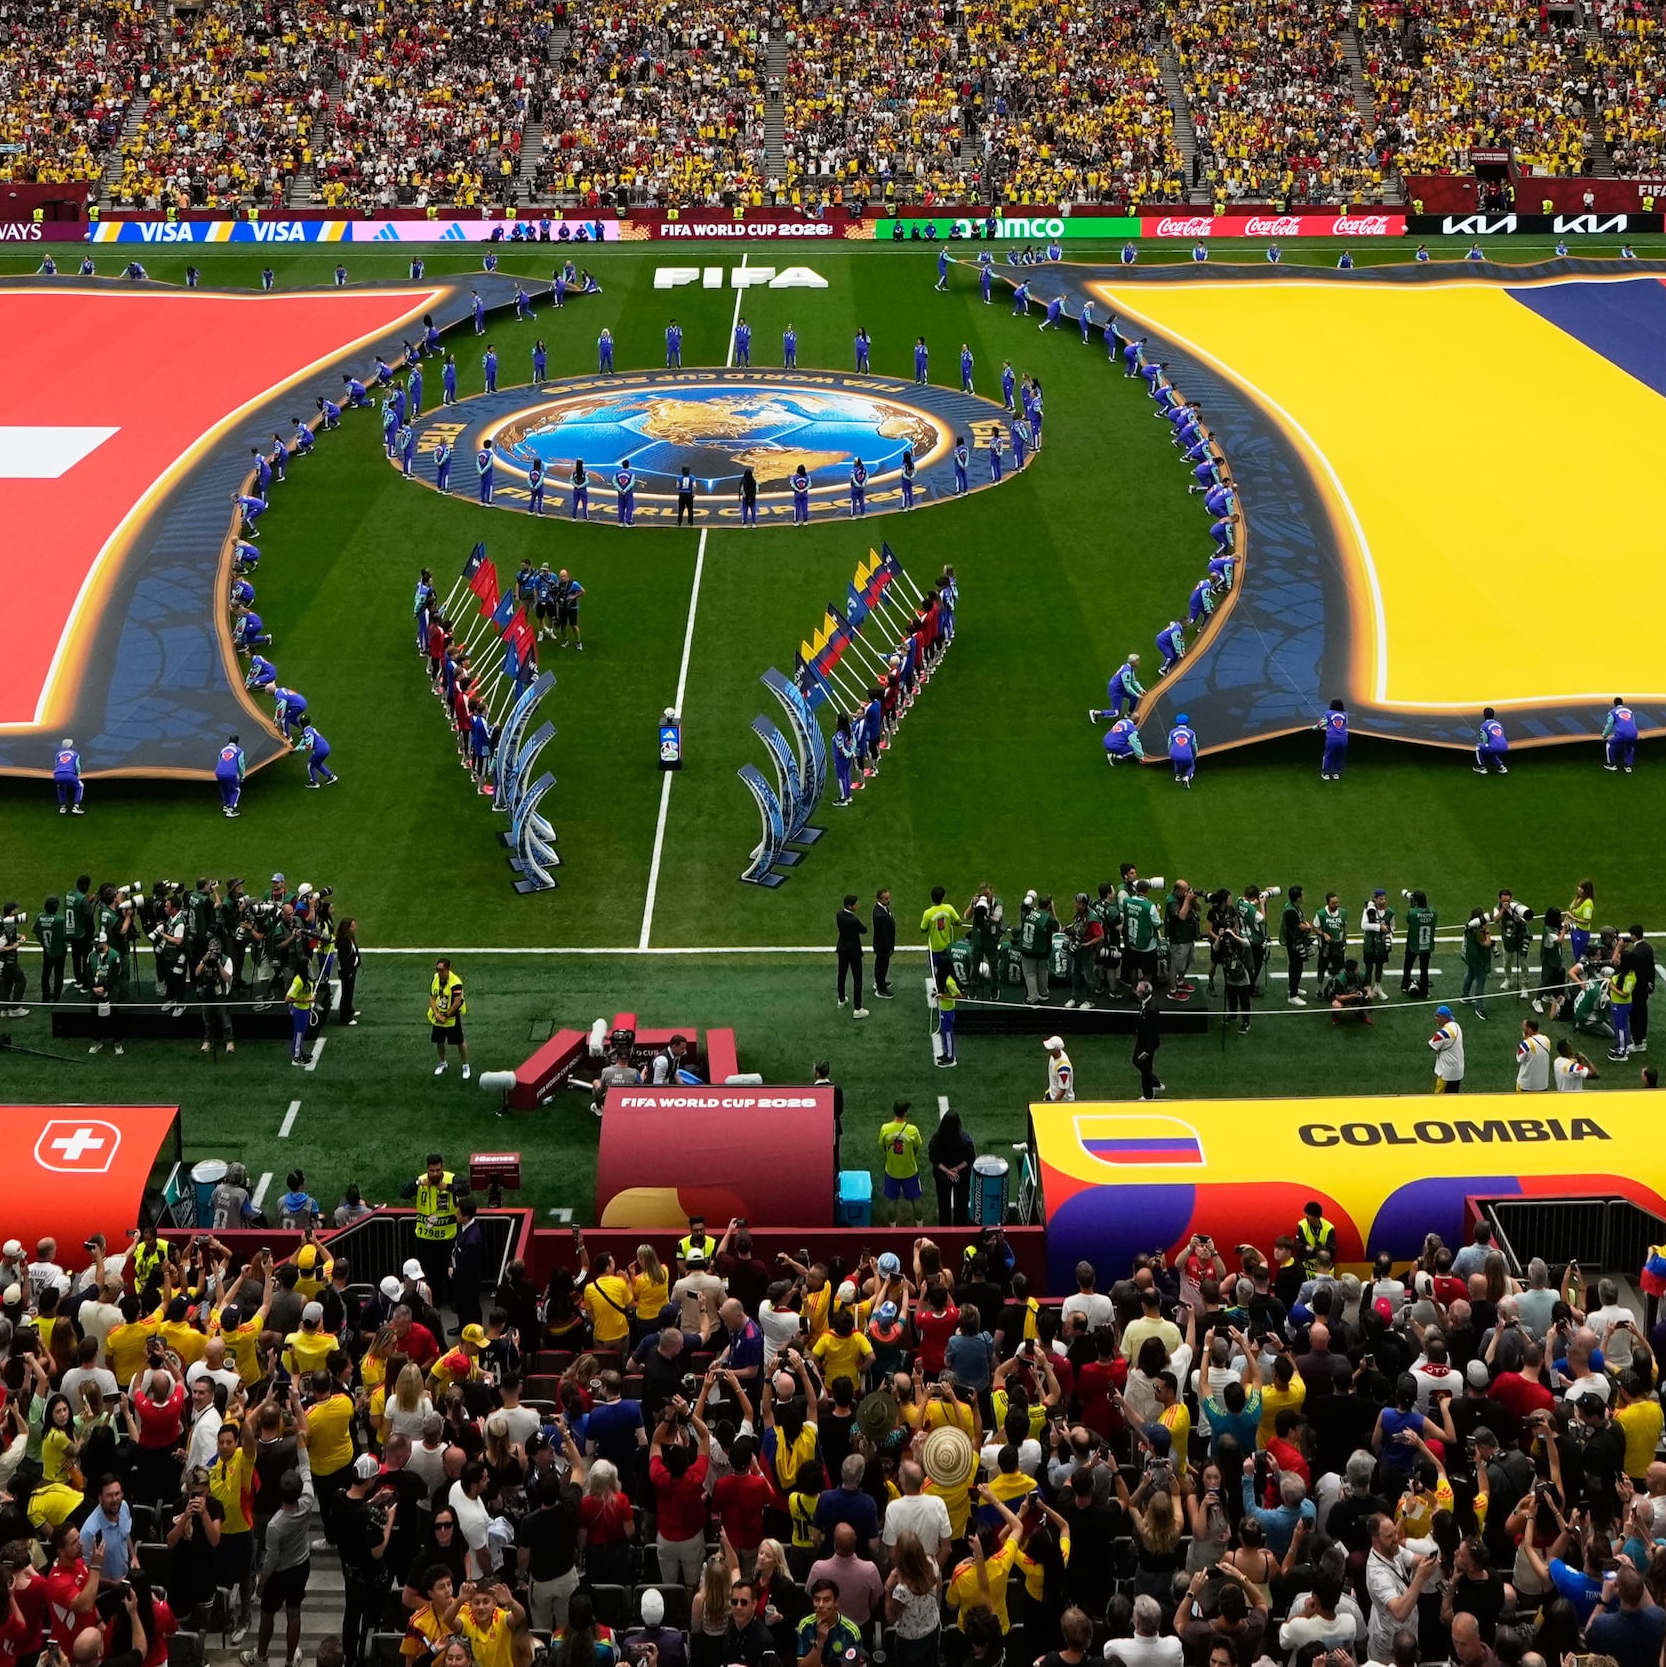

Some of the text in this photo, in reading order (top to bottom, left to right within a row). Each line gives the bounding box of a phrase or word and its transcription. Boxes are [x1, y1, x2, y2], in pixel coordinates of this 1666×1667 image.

[135, 222, 194, 242] VISA
[247, 222, 306, 242] VISA
[660, 224, 831, 237] FIFA WORLD CUP 2026
[1157, 216, 1215, 237] Coca-Cola
[1244, 216, 1301, 237] Coca-Cola
[1332, 216, 1389, 236] Coca-Cola
[1442, 215, 1517, 234] KIA
[1552, 214, 1627, 234] KIA
[653, 266, 829, 289] FIFA
[620, 1097, 817, 1108] FIFA WORLD CUP 2026
[1298, 1117, 1613, 1148] COLOMBIA
[474, 1154, 515, 1163] Hisense
